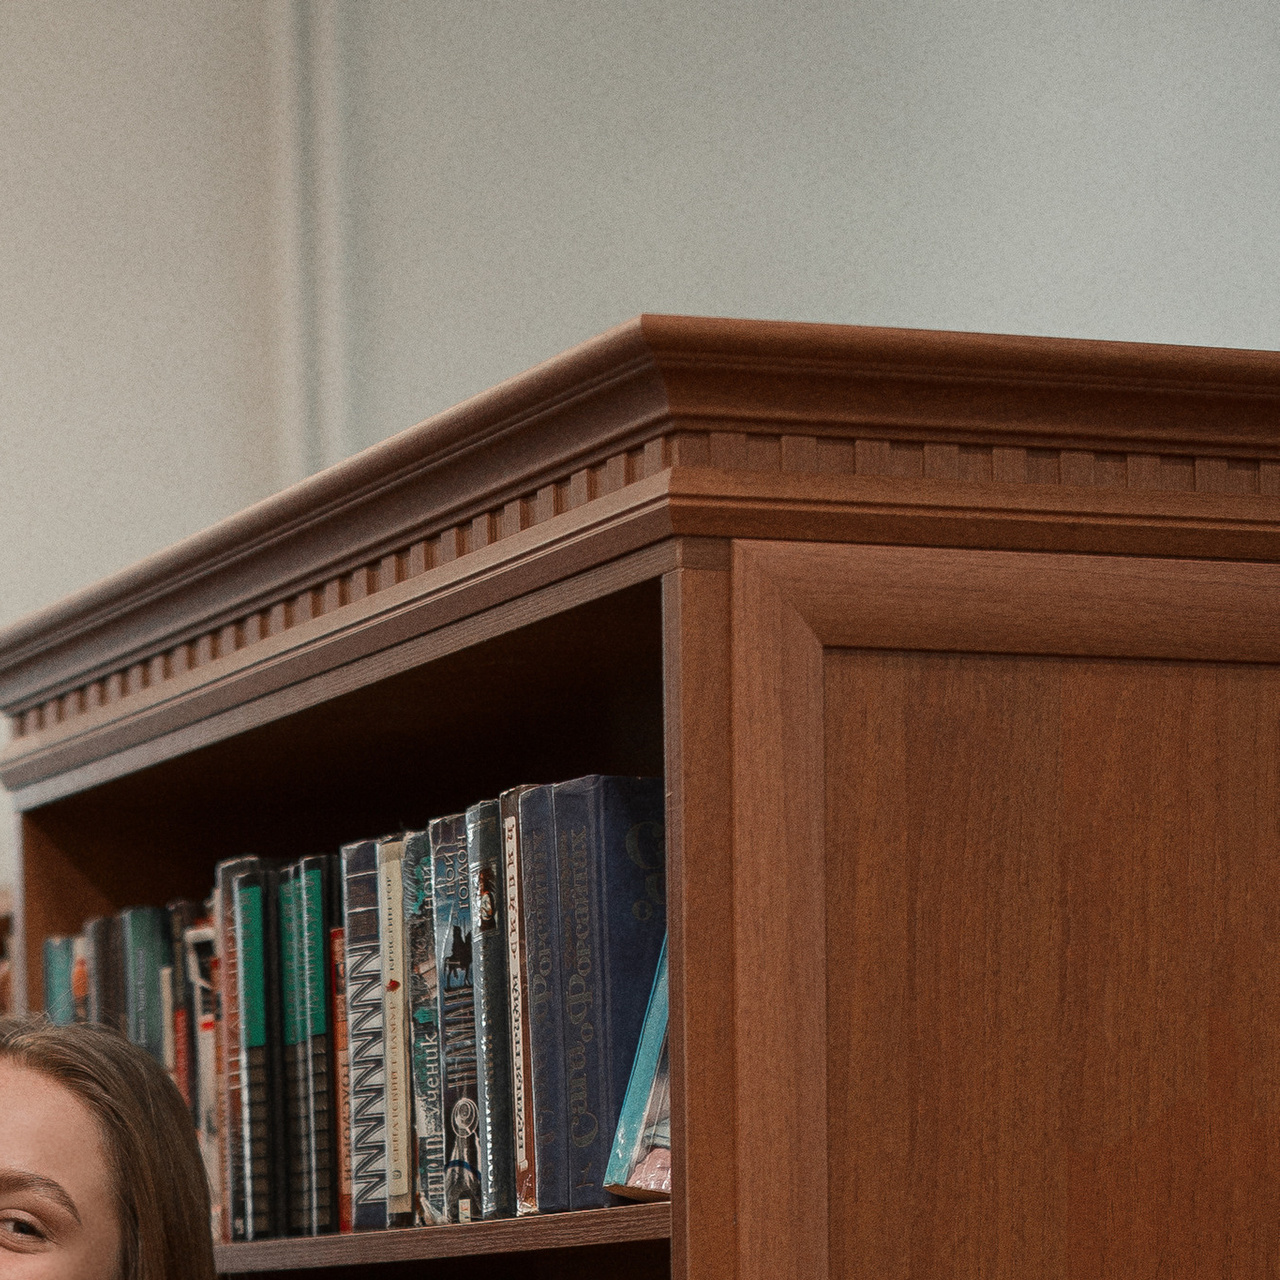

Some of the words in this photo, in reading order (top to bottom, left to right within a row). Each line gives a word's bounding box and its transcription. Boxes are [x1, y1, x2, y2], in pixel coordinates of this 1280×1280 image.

[441, 850, 455, 896] НОЙ
[457, 833, 468, 909] ГОРДОН
[564, 823, 594, 1024] Форсайтах
[419, 1029, 440, 1116] Ученик
[443, 985, 477, 1089] ШАМАН
